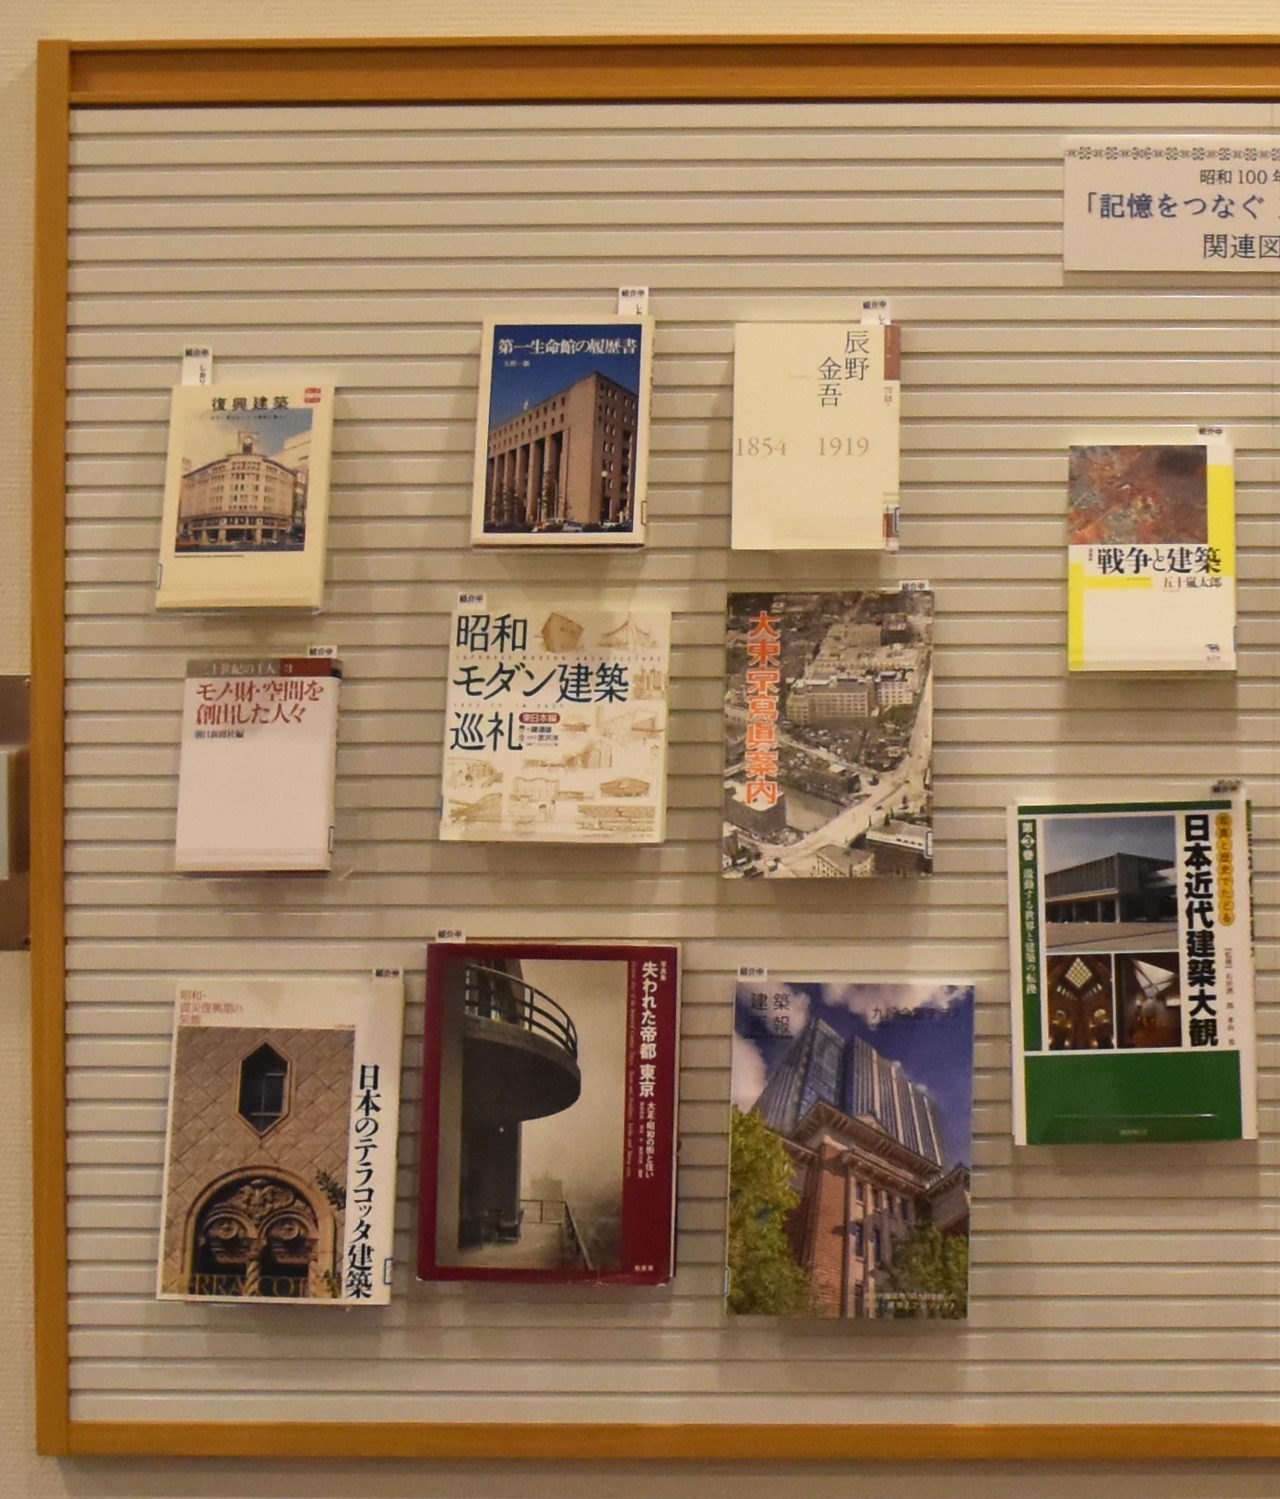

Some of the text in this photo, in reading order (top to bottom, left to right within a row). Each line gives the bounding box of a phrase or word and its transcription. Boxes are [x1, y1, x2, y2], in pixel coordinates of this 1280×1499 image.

[1087, 192, 1265, 221] 「記憶をつなぐ
[497, 337, 639, 355] 第一生命館の履歴書
[844, 329, 871, 382] 辰野
[816, 355, 843, 408] 金吾
[210, 395, 290, 412] 復興建築
[734, 436, 870, 457] 1854 1919
[1096, 546, 1222, 574] 戦争と建築
[1163, 576, 1223, 589] 五十嵐太郎
[455, 612, 529, 654] 昭和
[452, 661, 630, 704] モダン建築
[195, 702, 307, 726] 創出した人々
[449, 711, 524, 752] 巡礼
[1183, 814, 1219, 1048] 日本近代建築大観
[640, 960, 659, 1061] 失われた帝都
[750, 993, 791, 1011] 建築
[638, 1063, 656, 1098] 東京
[344, 1063, 383, 1300] 日本のテラコッタ建築
